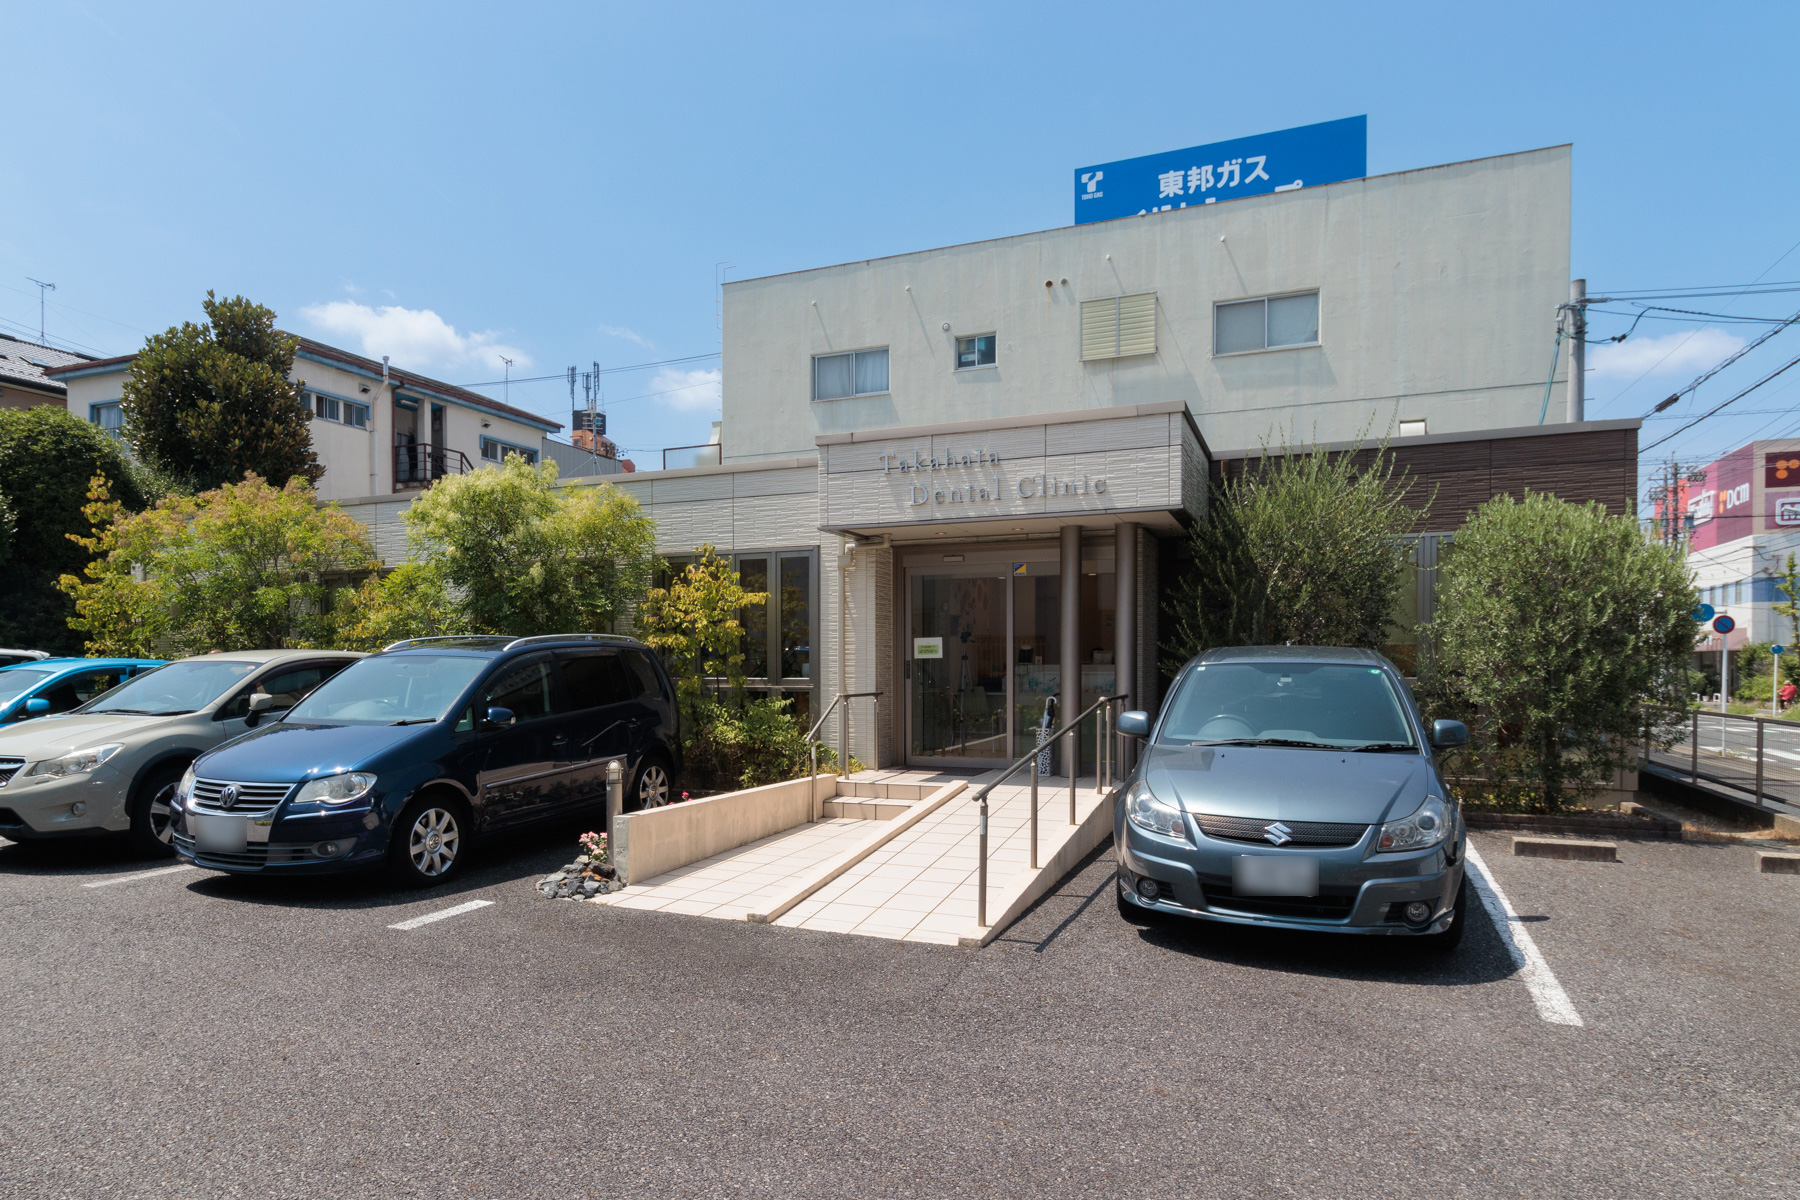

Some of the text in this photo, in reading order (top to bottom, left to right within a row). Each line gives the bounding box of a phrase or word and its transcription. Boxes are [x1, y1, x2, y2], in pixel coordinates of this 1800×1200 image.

[1158, 155, 1270, 199] 東邦ガス
[878, 447, 999, 474] Takahata
[909, 474, 1106, 506] Dental Clinic
